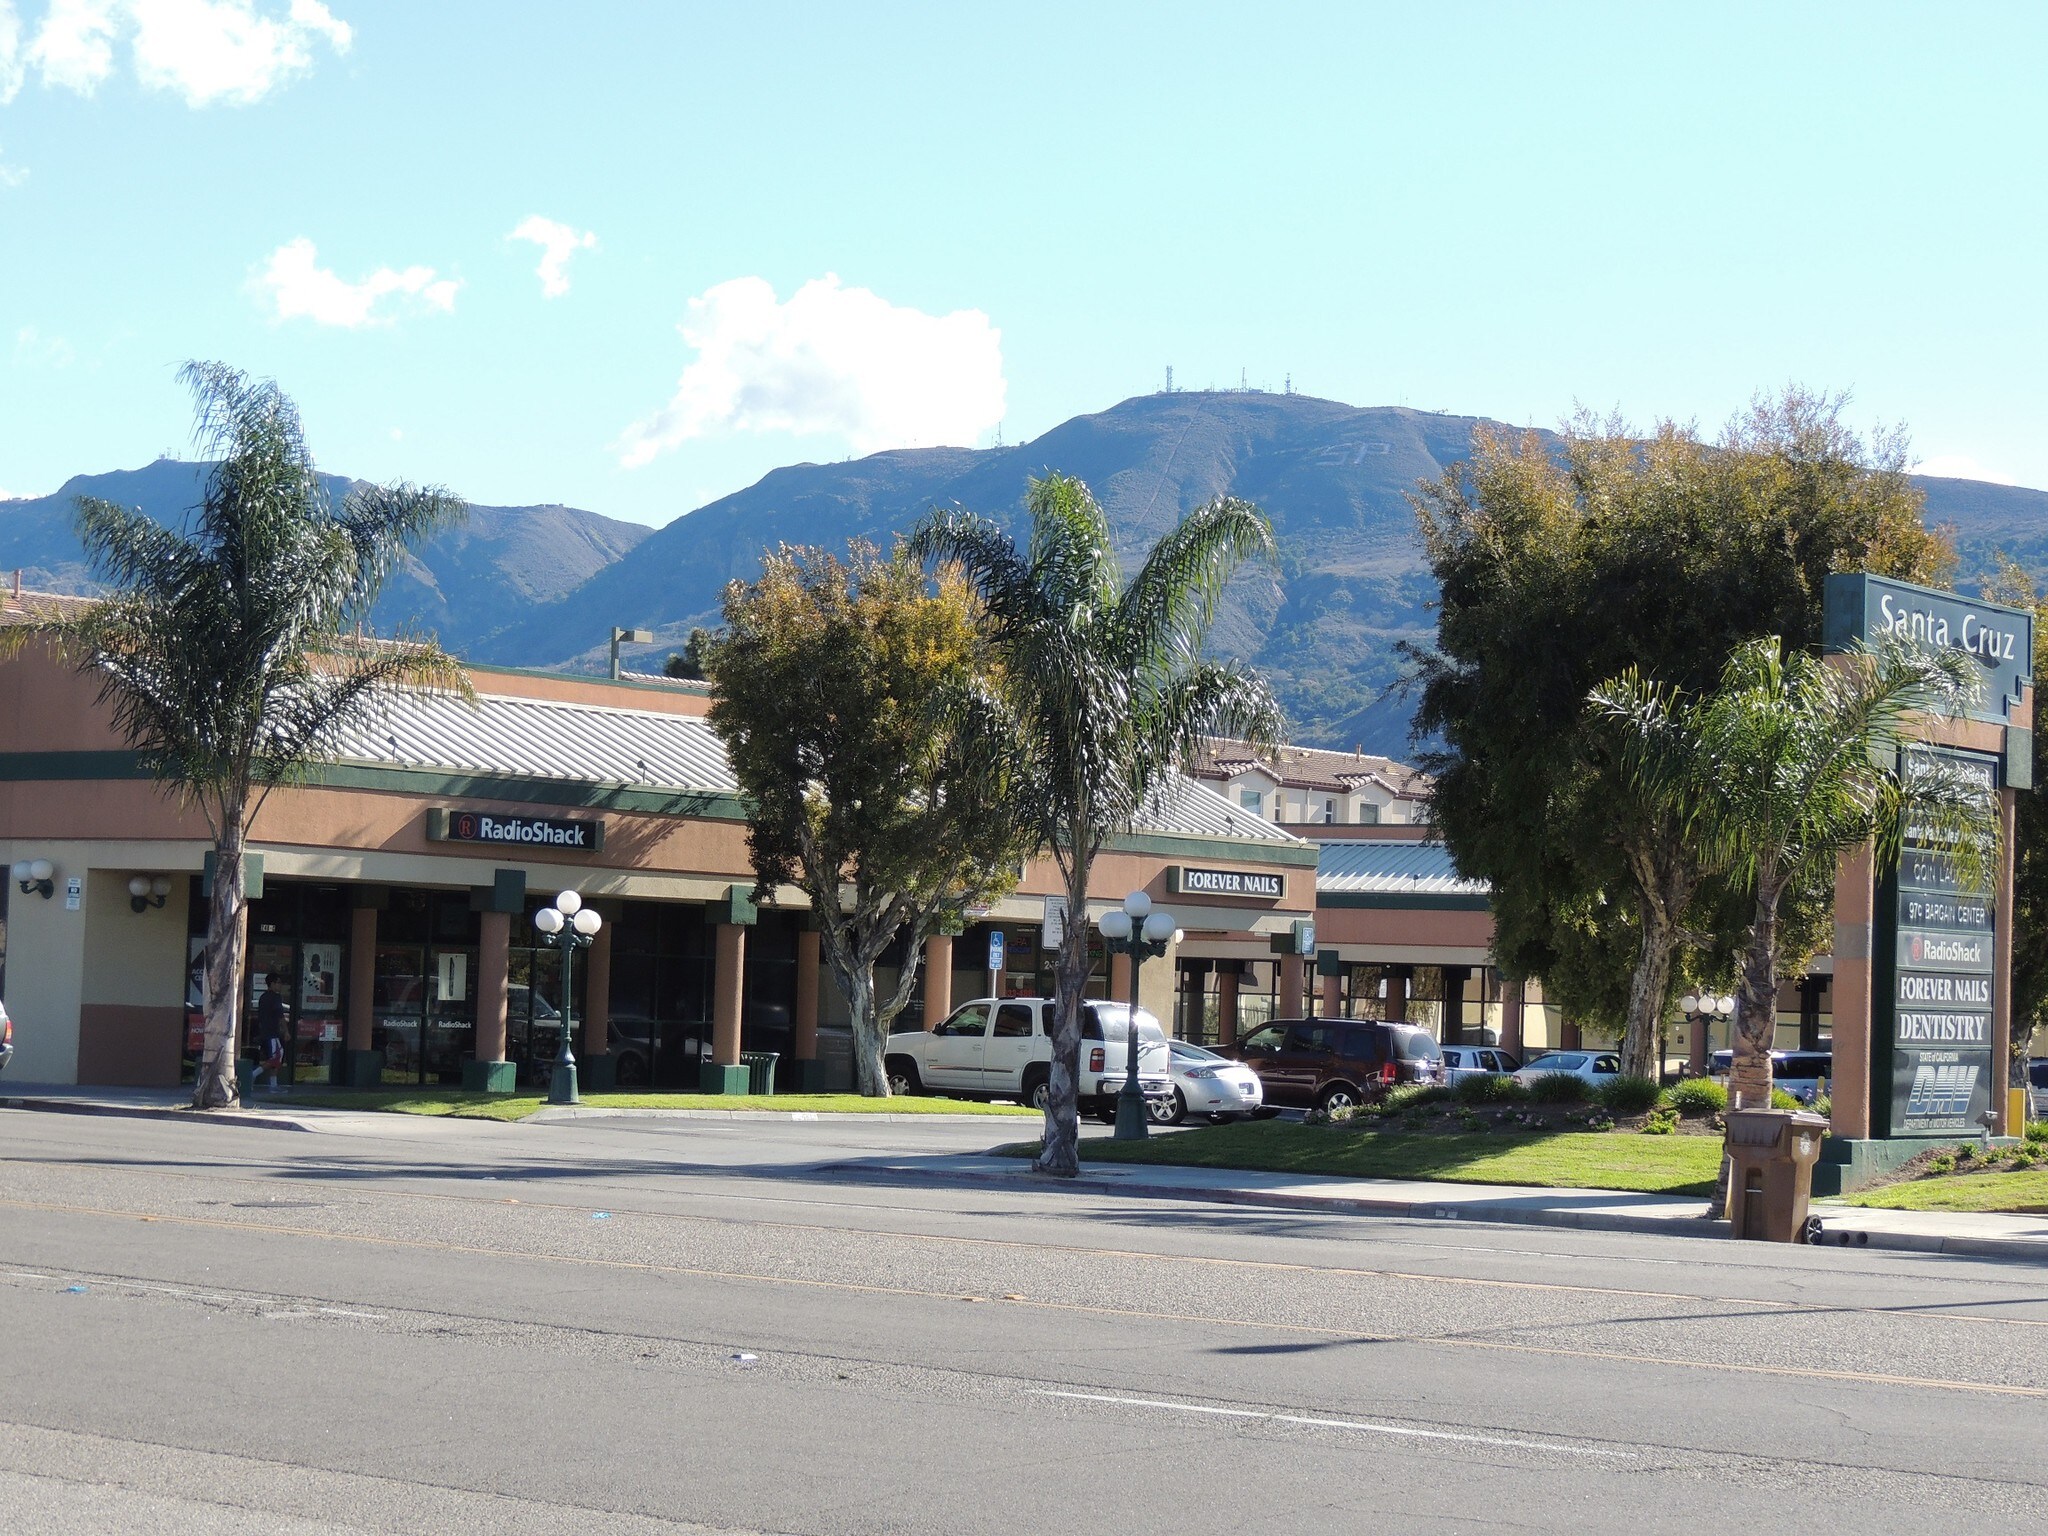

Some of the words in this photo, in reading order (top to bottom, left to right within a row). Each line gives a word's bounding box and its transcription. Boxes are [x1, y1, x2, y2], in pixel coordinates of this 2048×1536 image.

[1881, 594, 1951, 647] Santa
[1962, 614, 2015, 660] Cruz
[481, 817, 584, 846] RadioShack
[1188, 871, 1240, 891] FOREVER
[1244, 876, 1278, 894] NAILS
[1914, 863, 1935, 881] COIN
[1925, 903, 1955, 921] BARGAIN
[1958, 905, 1985, 923] CENTER
[1924, 940, 1980, 962] RadioShack
[1900, 977, 1952, 1000] FOREVER
[1955, 979, 1988, 1002] NAILS
[383, 1019, 417, 1028] RadioShack
[438, 1020, 472, 1029] RadioShack
[1900, 1014, 1985, 1040] DENTISTRY
[1906, 1065, 1980, 1115] DMV
